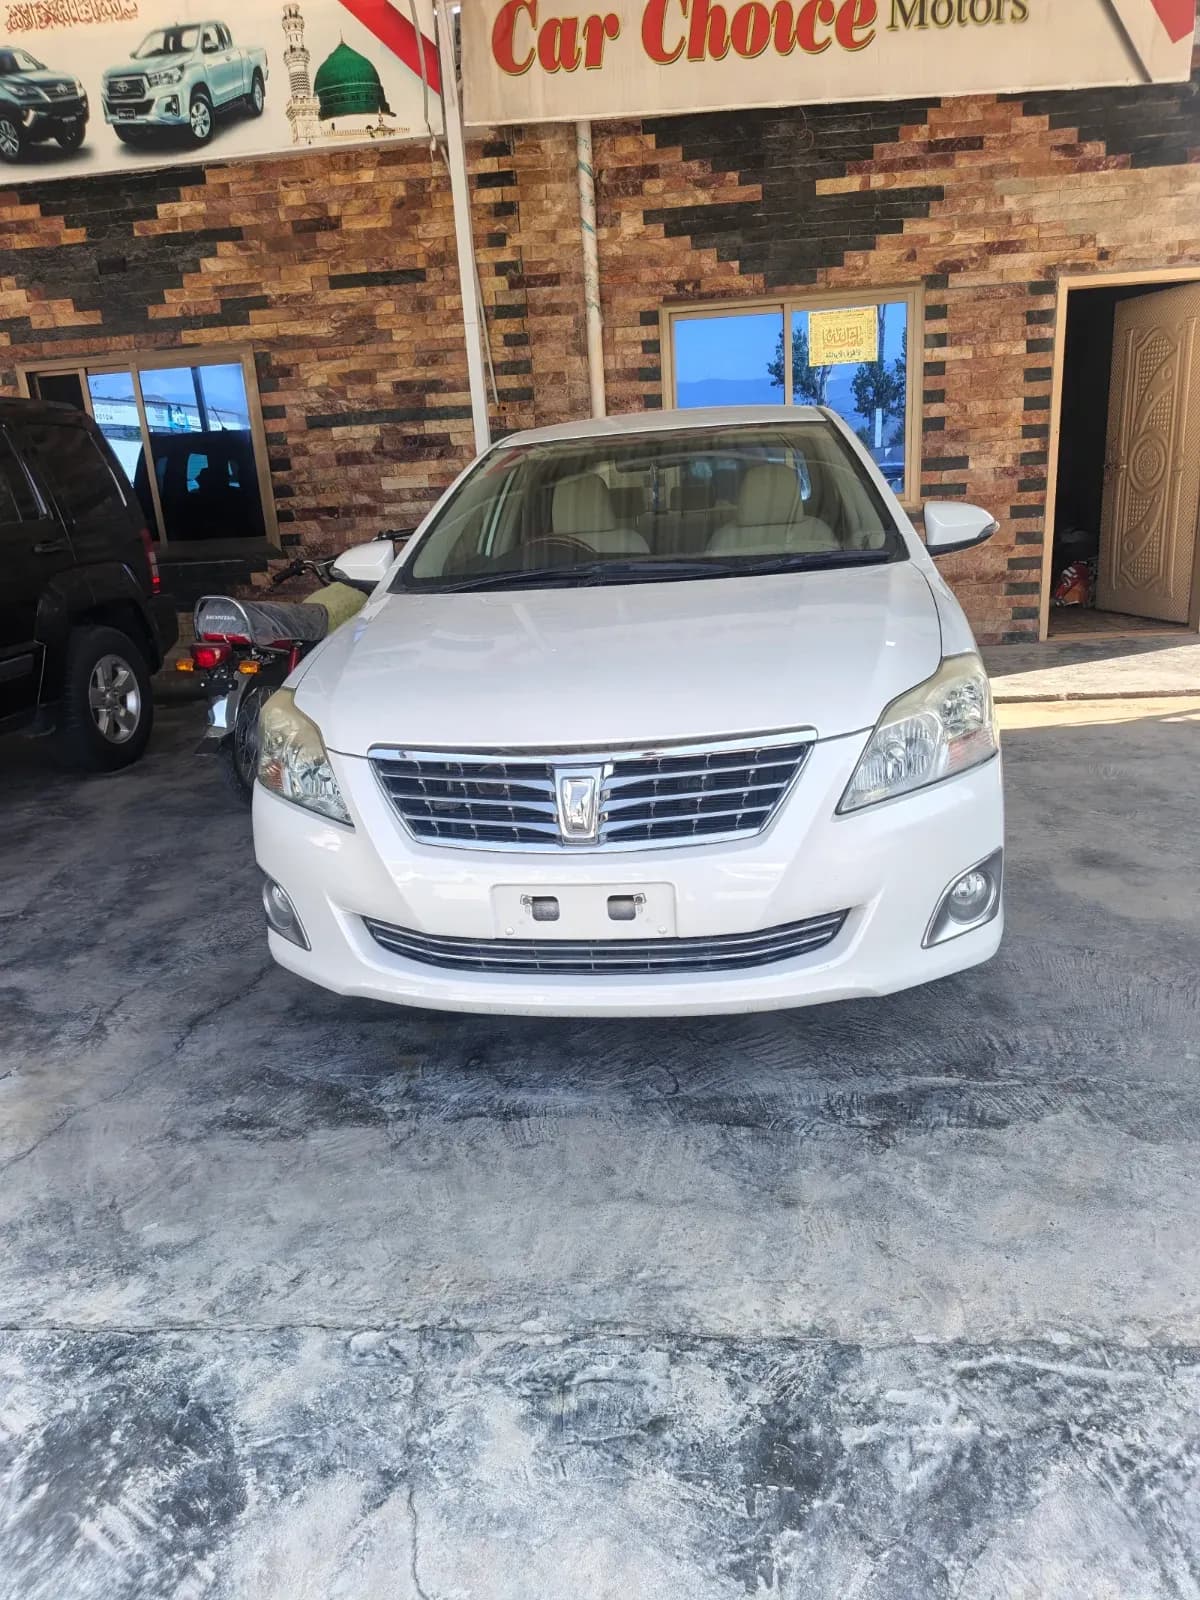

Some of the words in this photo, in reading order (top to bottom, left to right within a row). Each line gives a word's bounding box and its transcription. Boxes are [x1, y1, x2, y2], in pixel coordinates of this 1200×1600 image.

[492, 0, 620, 76] Car
[641, 0, 877, 65] Choice
[886, 0, 1030, 31] Motors
